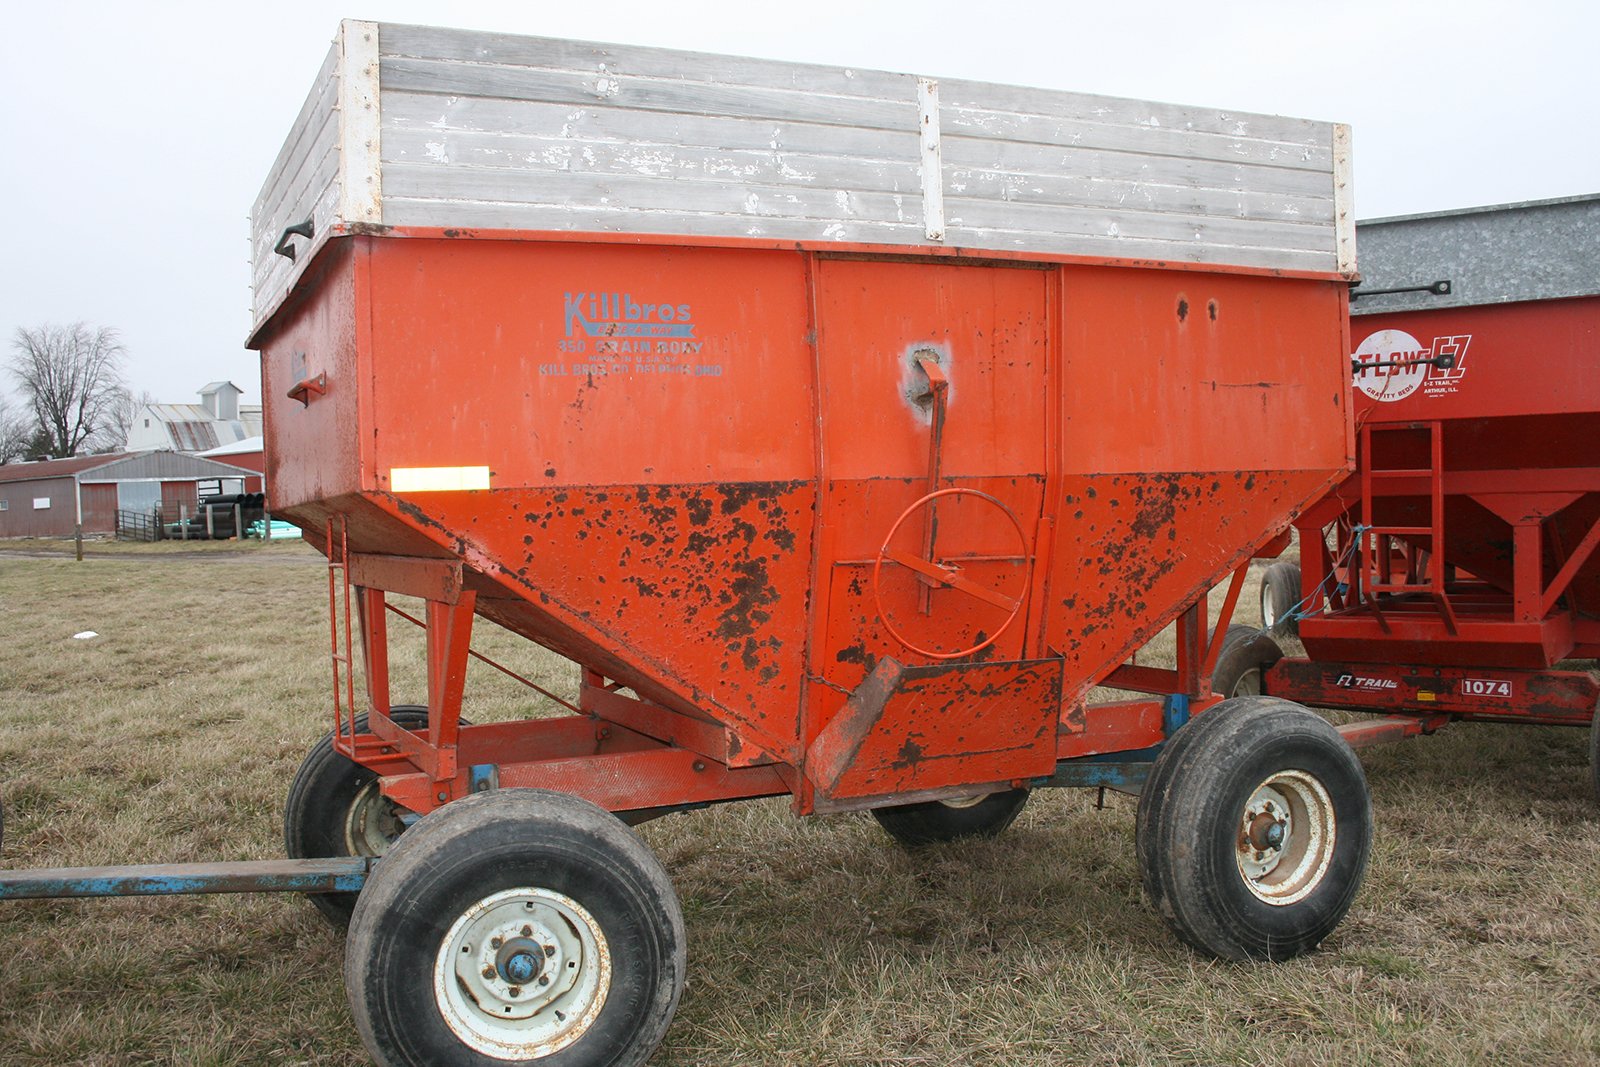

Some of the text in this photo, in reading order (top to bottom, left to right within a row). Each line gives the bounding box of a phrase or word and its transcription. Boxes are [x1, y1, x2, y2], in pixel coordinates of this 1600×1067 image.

[564, 292, 691, 336] Killbros
[559, 340, 585, 353] 350
[595, 341, 650, 354] GRAIN
[539, 364, 568, 376] KILL
[572, 364, 607, 376] BROS
[695, 365, 722, 377] OHIO
[1398, 384, 1414, 397] BEDS
[1464, 680, 1509, 695] 1074
